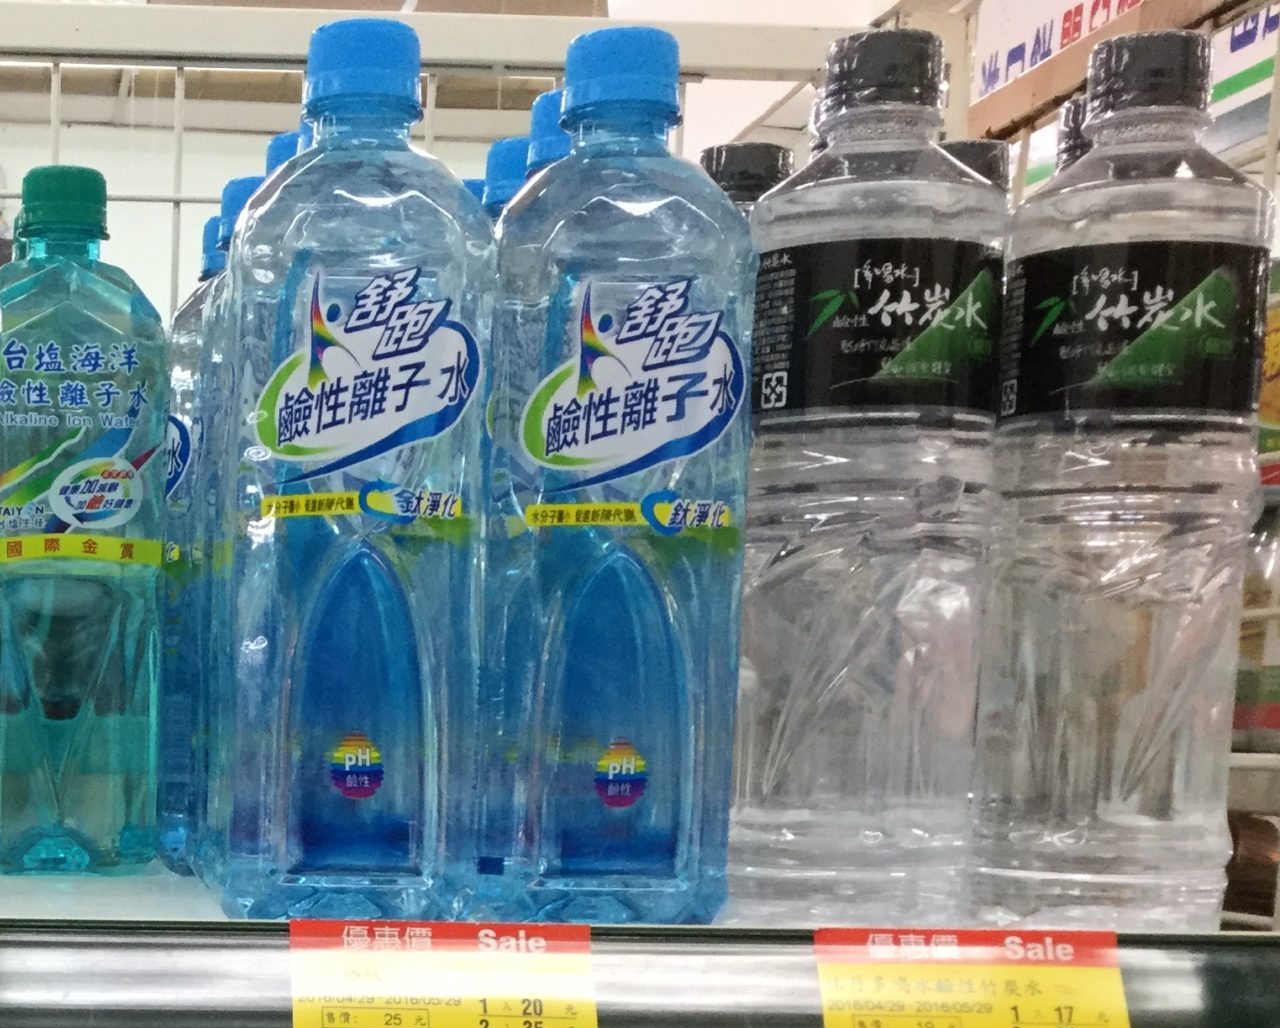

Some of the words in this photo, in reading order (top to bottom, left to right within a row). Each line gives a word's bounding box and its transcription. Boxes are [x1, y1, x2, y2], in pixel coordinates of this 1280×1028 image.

[344, 266, 452, 360] 舒跑
[868, 283, 988, 330] 竹炭水
[1085, 285, 1225, 331] 竹炭水
[615, 278, 724, 371] 舒跑
[277, 351, 469, 447] 鹼性離子水
[545, 363, 736, 457] 鹼性離子水
[67, 413, 91, 427] Ion
[100, 414, 140, 428] Water
[6, 538, 135, 560] 國際金賞
[478, 929, 547, 953] Sale
[1004, 937, 1074, 961] Sale
[480, 998, 488, 1015] 1
[522, 998, 543, 1016] 20
[1011, 1006, 1020, 1023] 1
[1054, 1006, 1074, 1023] 17
[384, 1013, 402, 1026] 25
